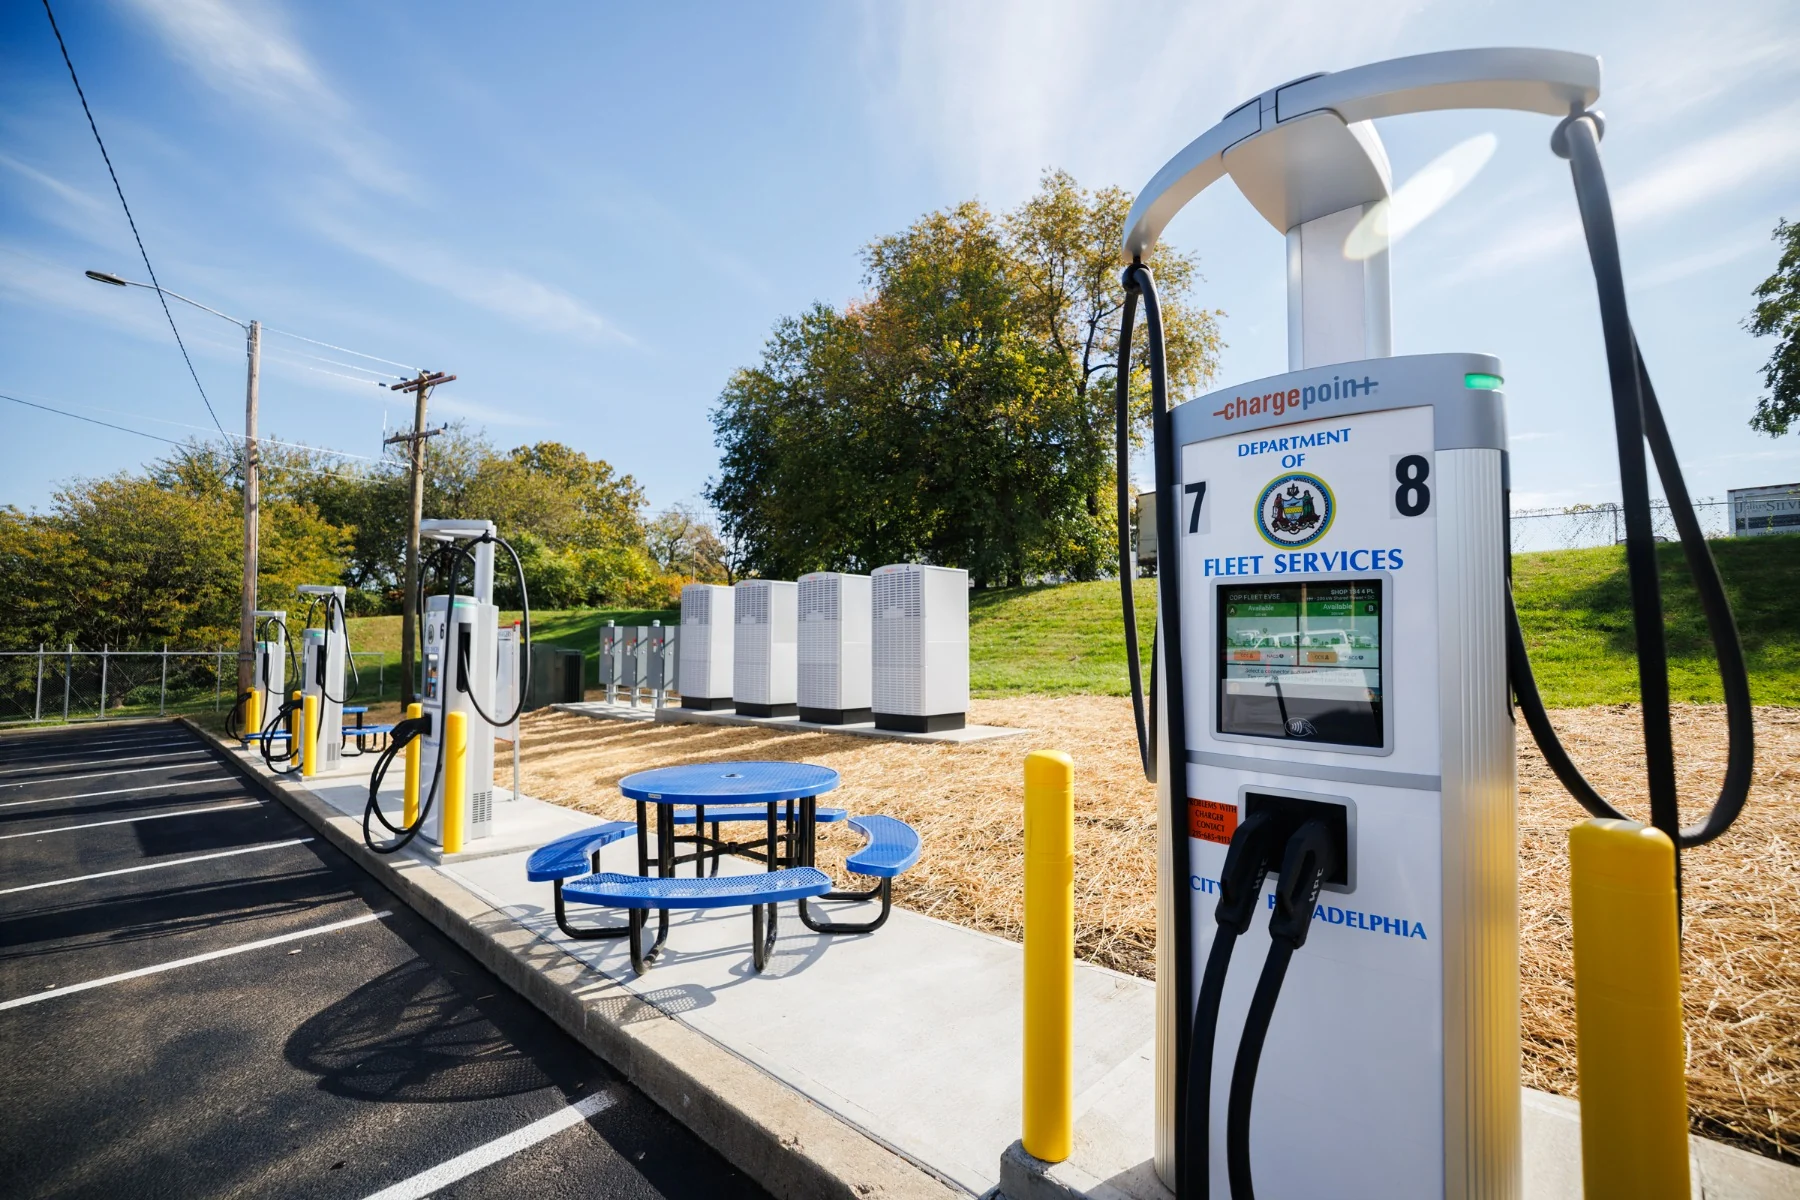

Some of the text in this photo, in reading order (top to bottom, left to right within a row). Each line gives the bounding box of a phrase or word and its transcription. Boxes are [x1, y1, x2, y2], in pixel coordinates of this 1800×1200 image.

[1238, 428, 1351, 457] DEPARTMENT
[1281, 453, 1305, 468] OF
[1395, 454, 1431, 517] 8
[1184, 481, 1207, 534] 7
[1766, 500, 1800, 511] SILV
[1204, 549, 1404, 576] FLEET SERVICES
[440, 623, 445, 640] 6
[1187, 798, 1238, 813] ROBLEMS WITH
[1195, 809, 1224, 821] CHARGER
[1196, 820, 1225, 832] CONTACT
[1267, 893, 1428, 940] PADELPHIA
